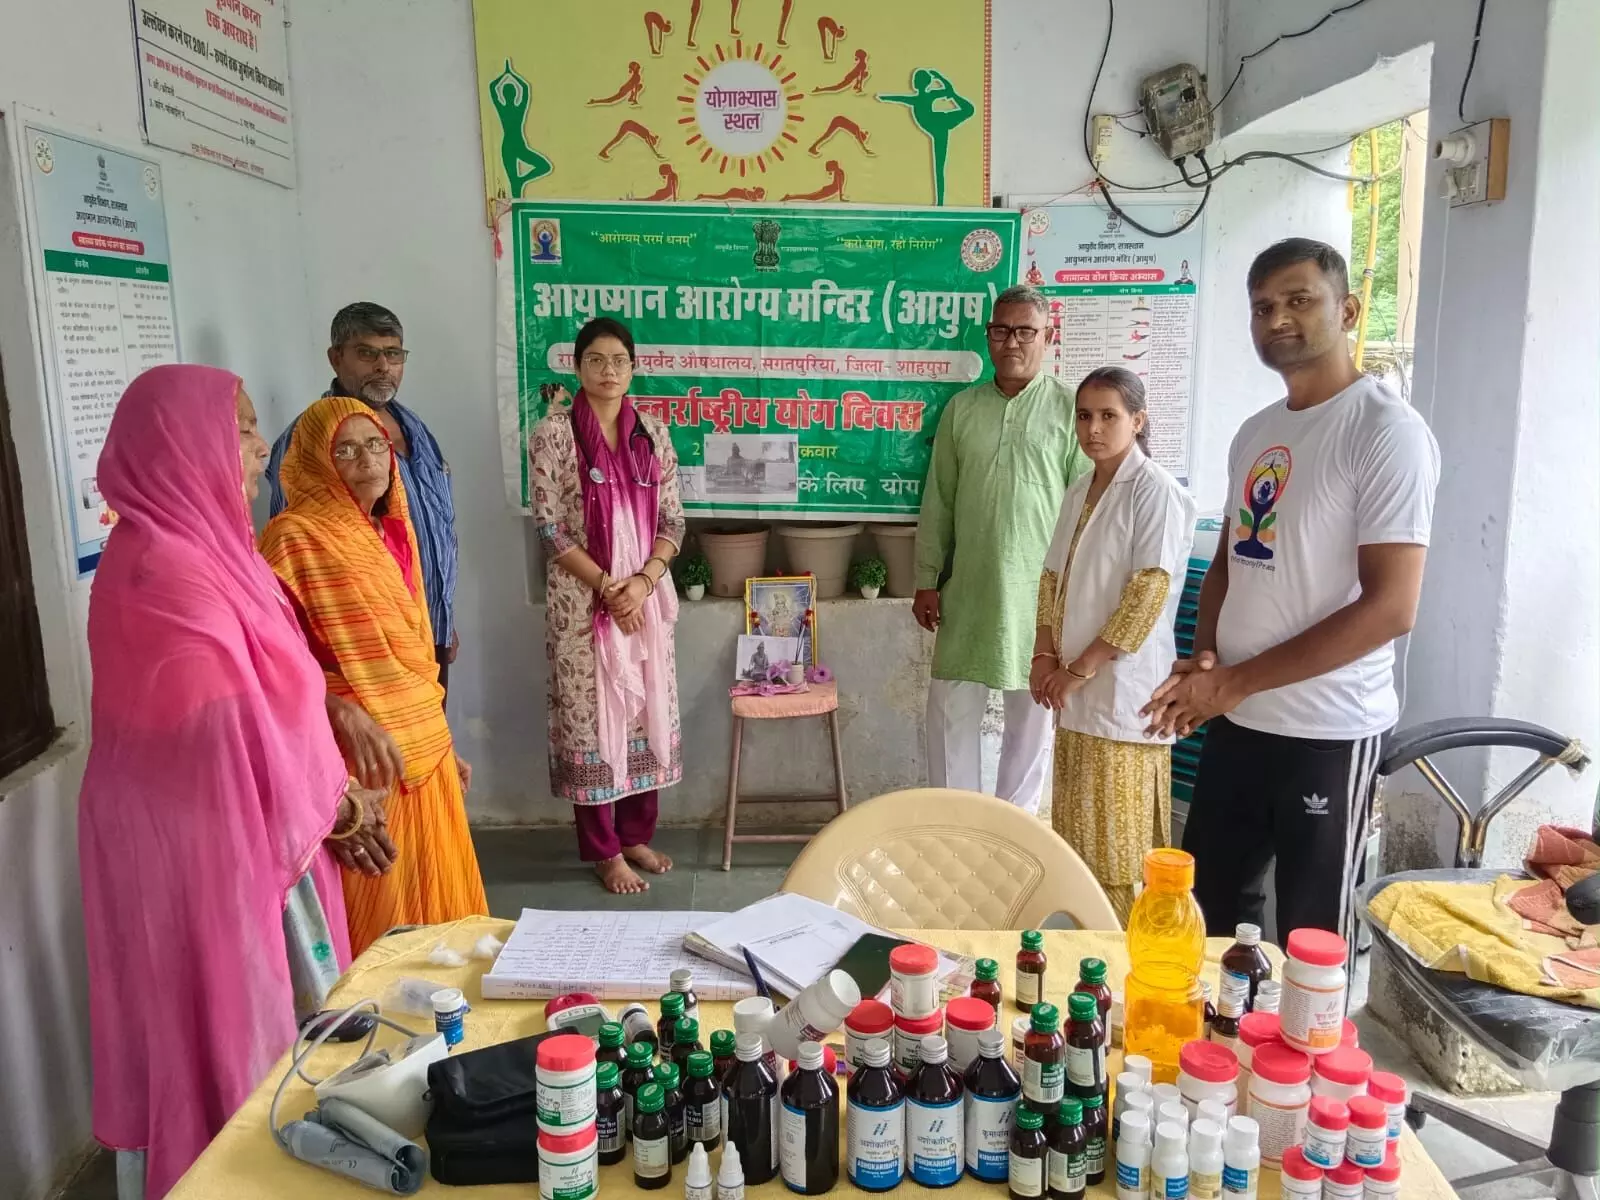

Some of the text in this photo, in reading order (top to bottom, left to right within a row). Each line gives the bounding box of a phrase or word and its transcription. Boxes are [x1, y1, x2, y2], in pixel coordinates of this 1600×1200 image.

[205, 8, 221, 31] एक
[221, 18, 248, 47] अपराध
[241, 3, 262, 29] करना
[168, 24, 184, 46] करने
[184, 32, 192, 49] पर
[704, 86, 778, 130] योगाभ्यास स्थल
[533, 282, 668, 330] आयुष्मान
[675, 276, 782, 321] आरोग्य
[787, 278, 873, 323] मन्दिर
[895, 359, 952, 379] शाहपुरा
[625, 387, 926, 433] न्तर्राष्ट्रीय योग दिवस
[798, 445, 838, 459] क्रवार
[798, 470, 921, 499] के लिए योग
